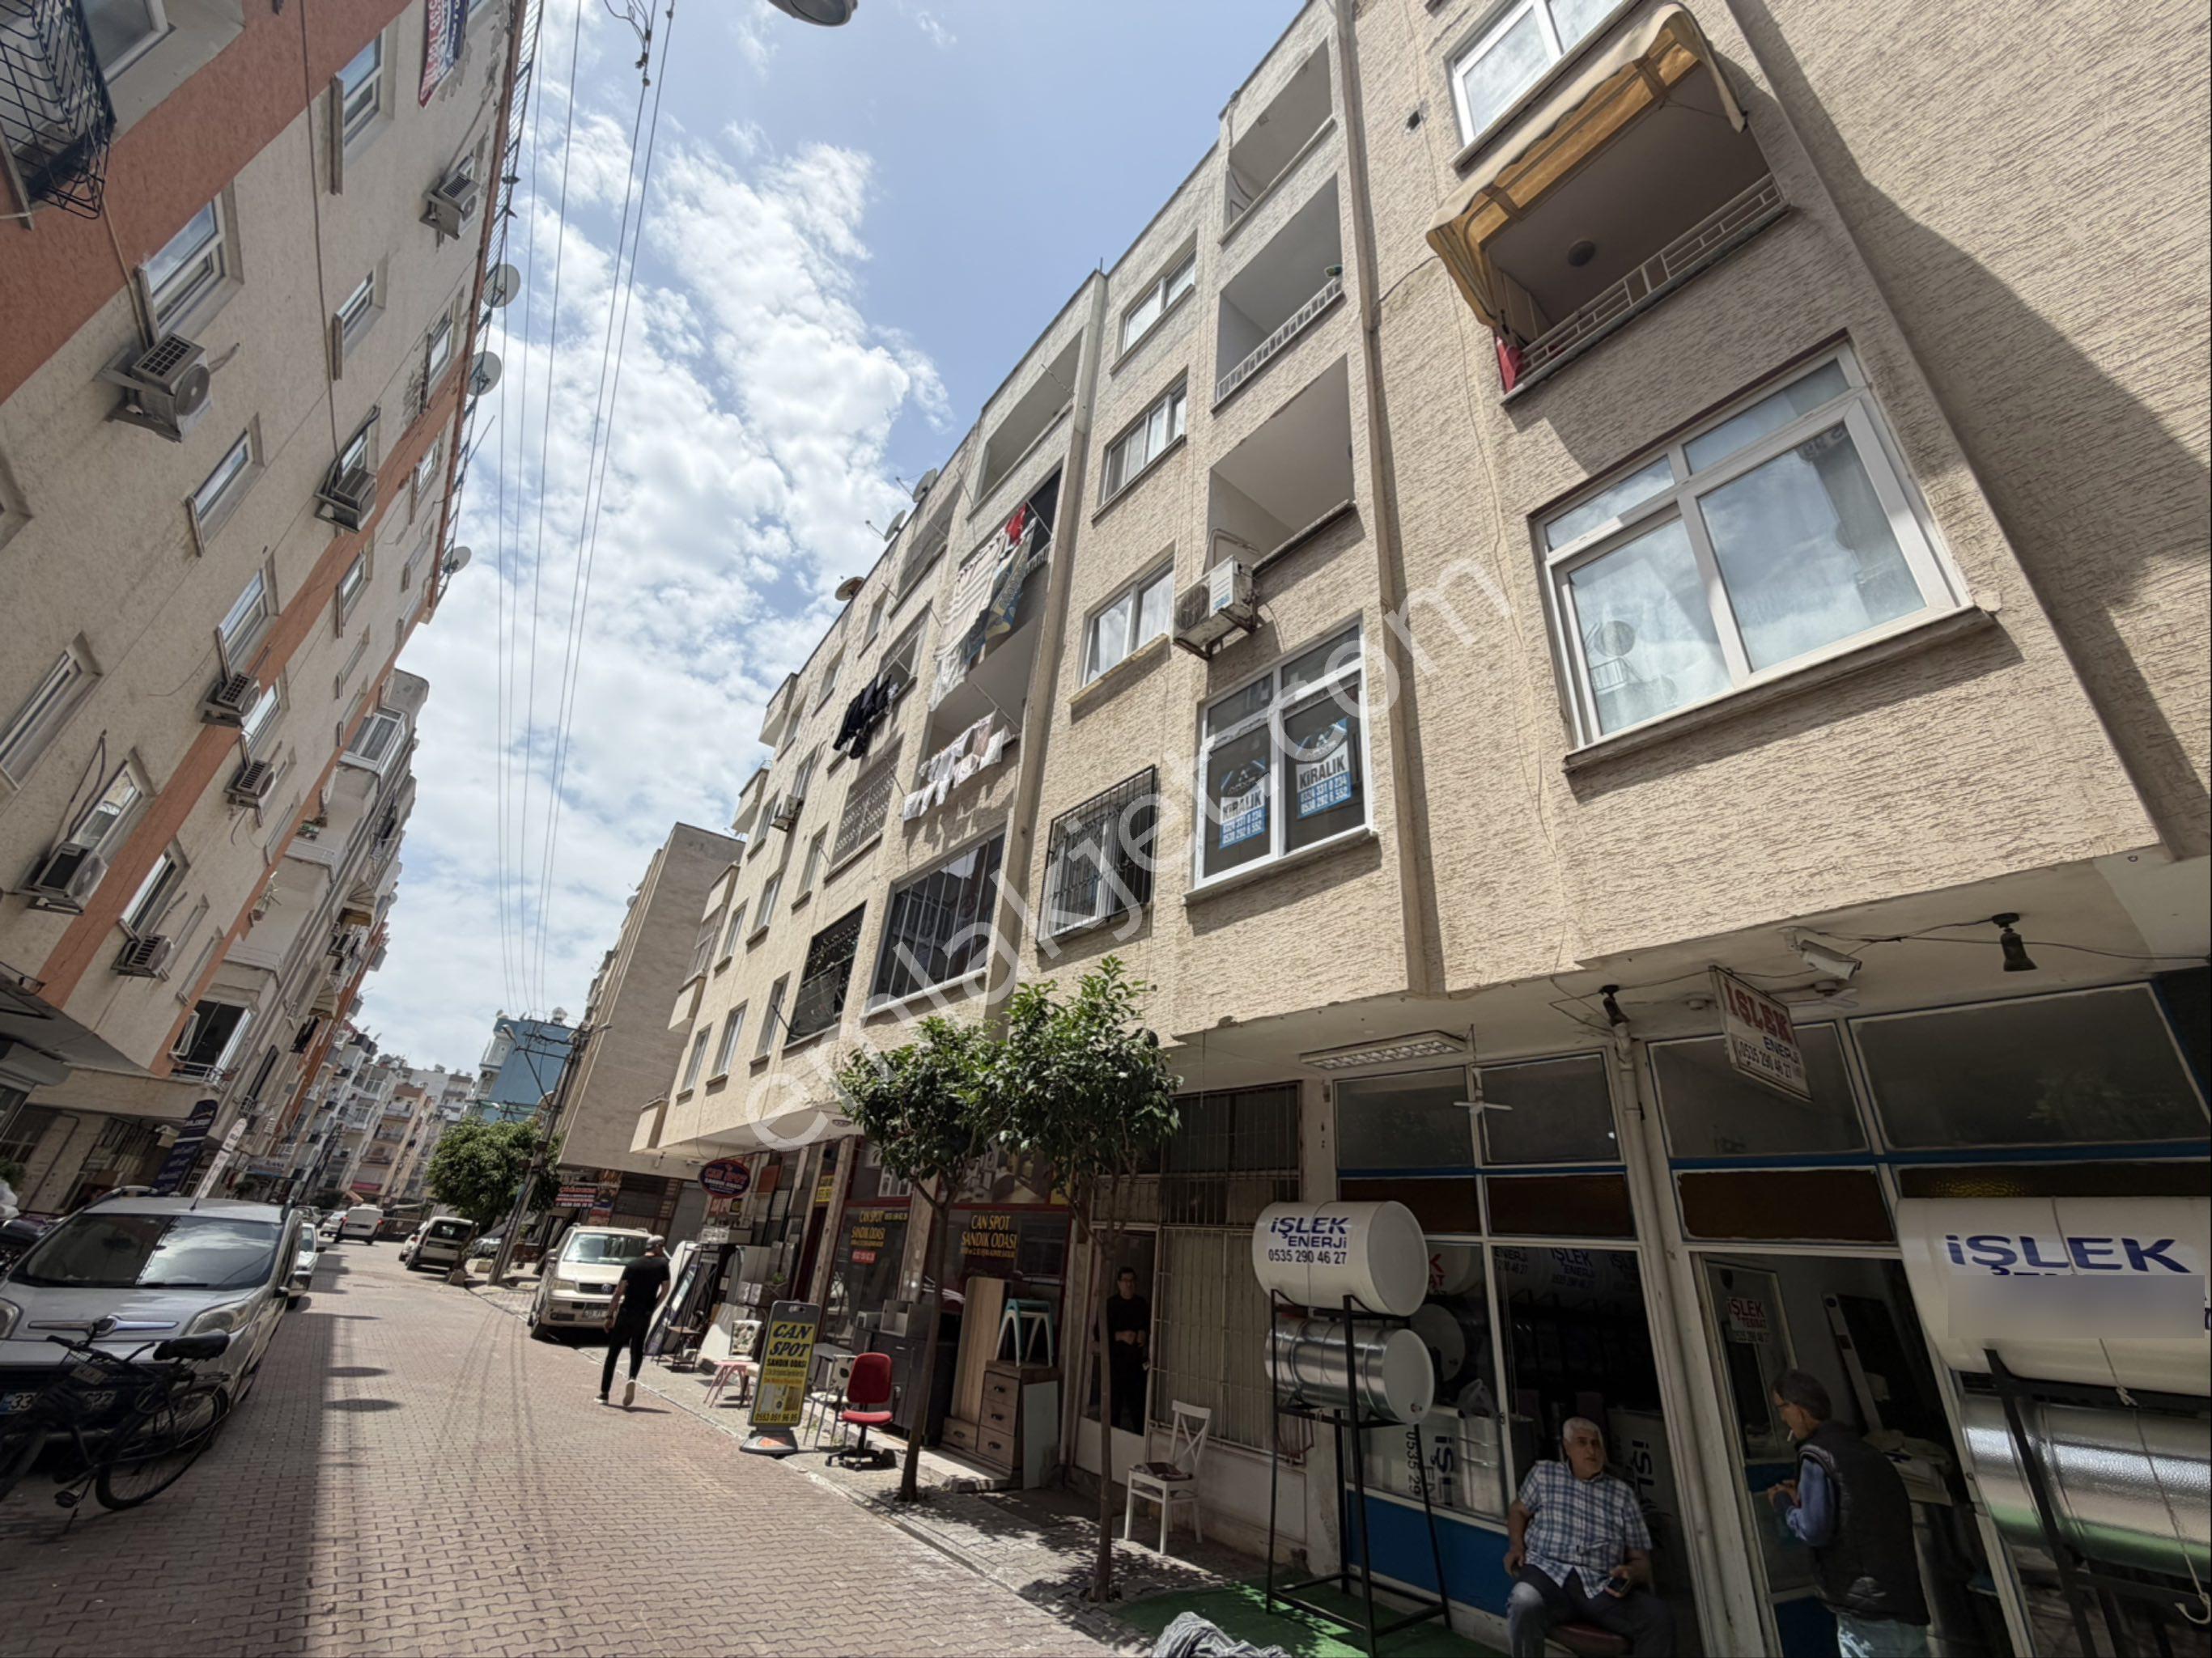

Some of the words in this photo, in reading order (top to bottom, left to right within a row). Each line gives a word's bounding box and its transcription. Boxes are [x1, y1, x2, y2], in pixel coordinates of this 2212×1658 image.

[971, 1215, 988, 1229] CAN
[988, 1215, 1010, 1230] SPOT
[991, 1232, 1018, 1249] ODASI
[1268, 1249, 1293, 1262] 0535
[1295, 1250, 1314, 1263] 290
[1317, 1251, 1331, 1264] 46
[1334, 1252, 1347, 1265] 27
[772, 1324, 813, 1339] CAN
[770, 1341, 810, 1357] SPOT
